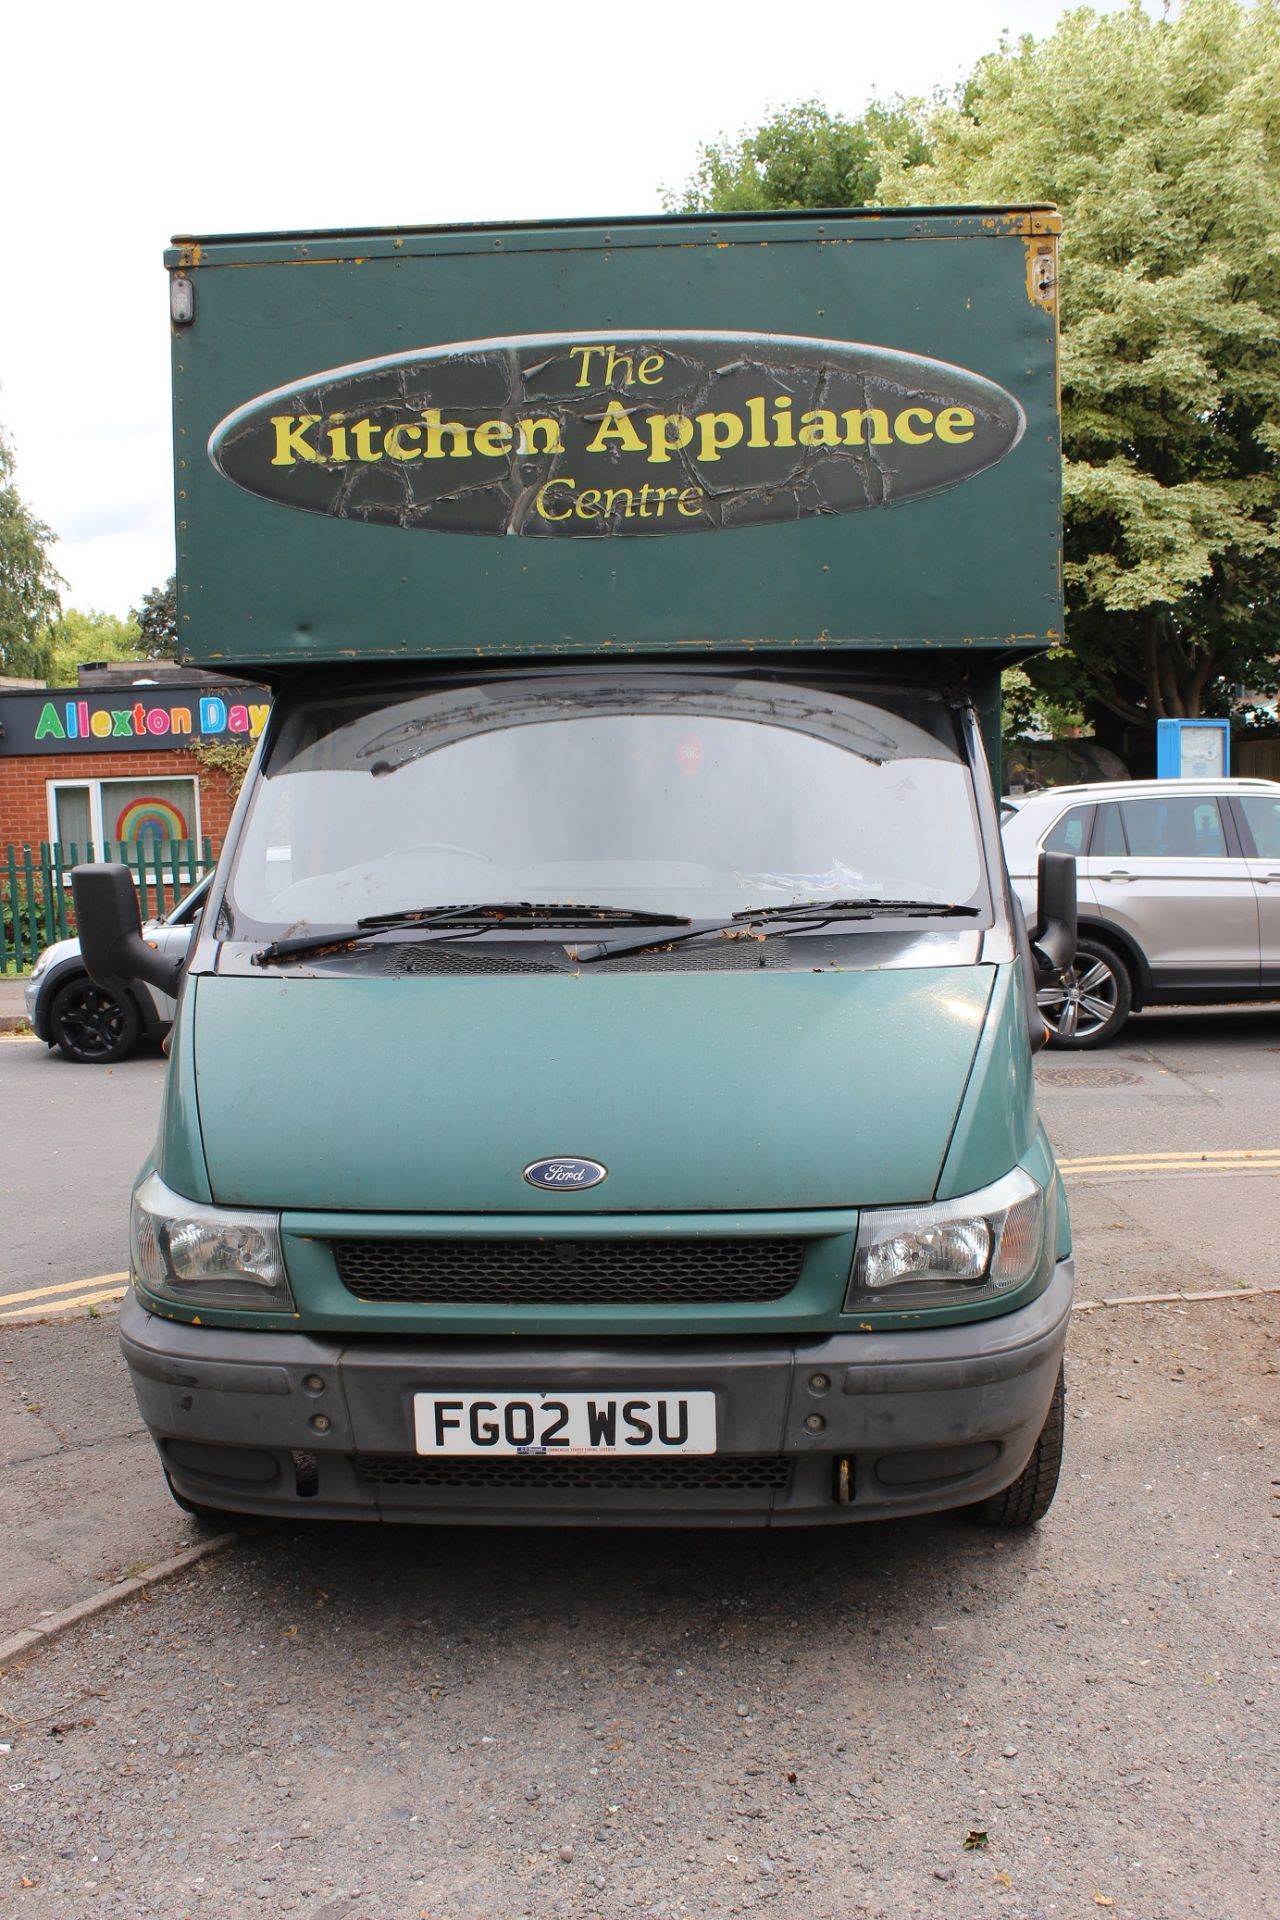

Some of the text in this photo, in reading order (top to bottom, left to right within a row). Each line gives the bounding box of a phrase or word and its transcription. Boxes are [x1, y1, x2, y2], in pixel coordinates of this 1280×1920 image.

[569, 345, 665, 388] The
[270, 395, 976, 467] Kitchen Appliance
[536, 477, 705, 521] Centre
[34, 696, 271, 740] Allexton Day
[544, 1164, 586, 1181] Ford
[433, 1400, 688, 1447] FG02 WSU
